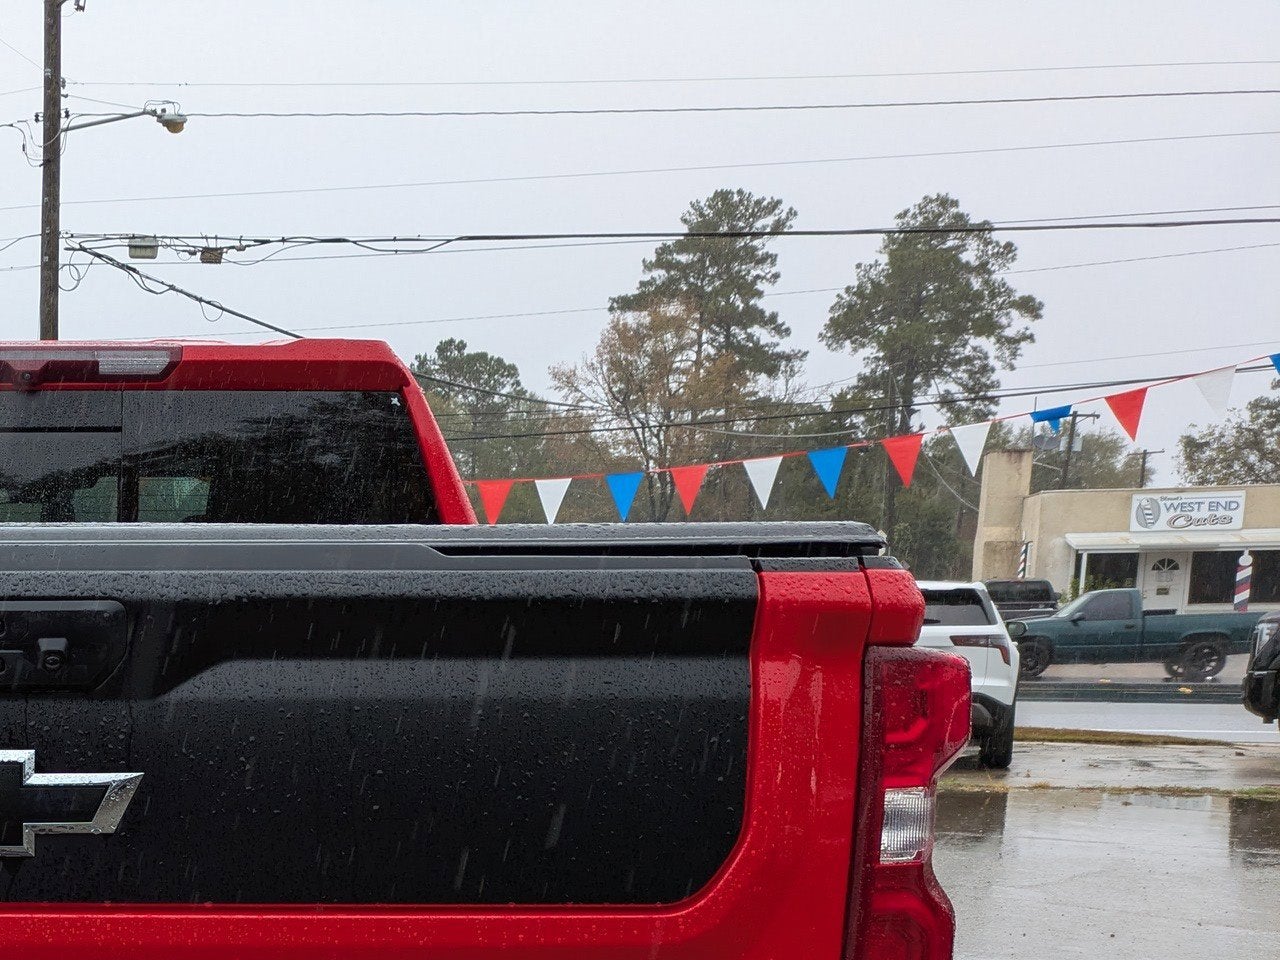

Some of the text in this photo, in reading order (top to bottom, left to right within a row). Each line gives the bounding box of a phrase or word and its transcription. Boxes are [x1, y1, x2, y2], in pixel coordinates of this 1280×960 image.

[1163, 500, 1240, 513] WEST END
[1166, 513, 1233, 529] Cuts
